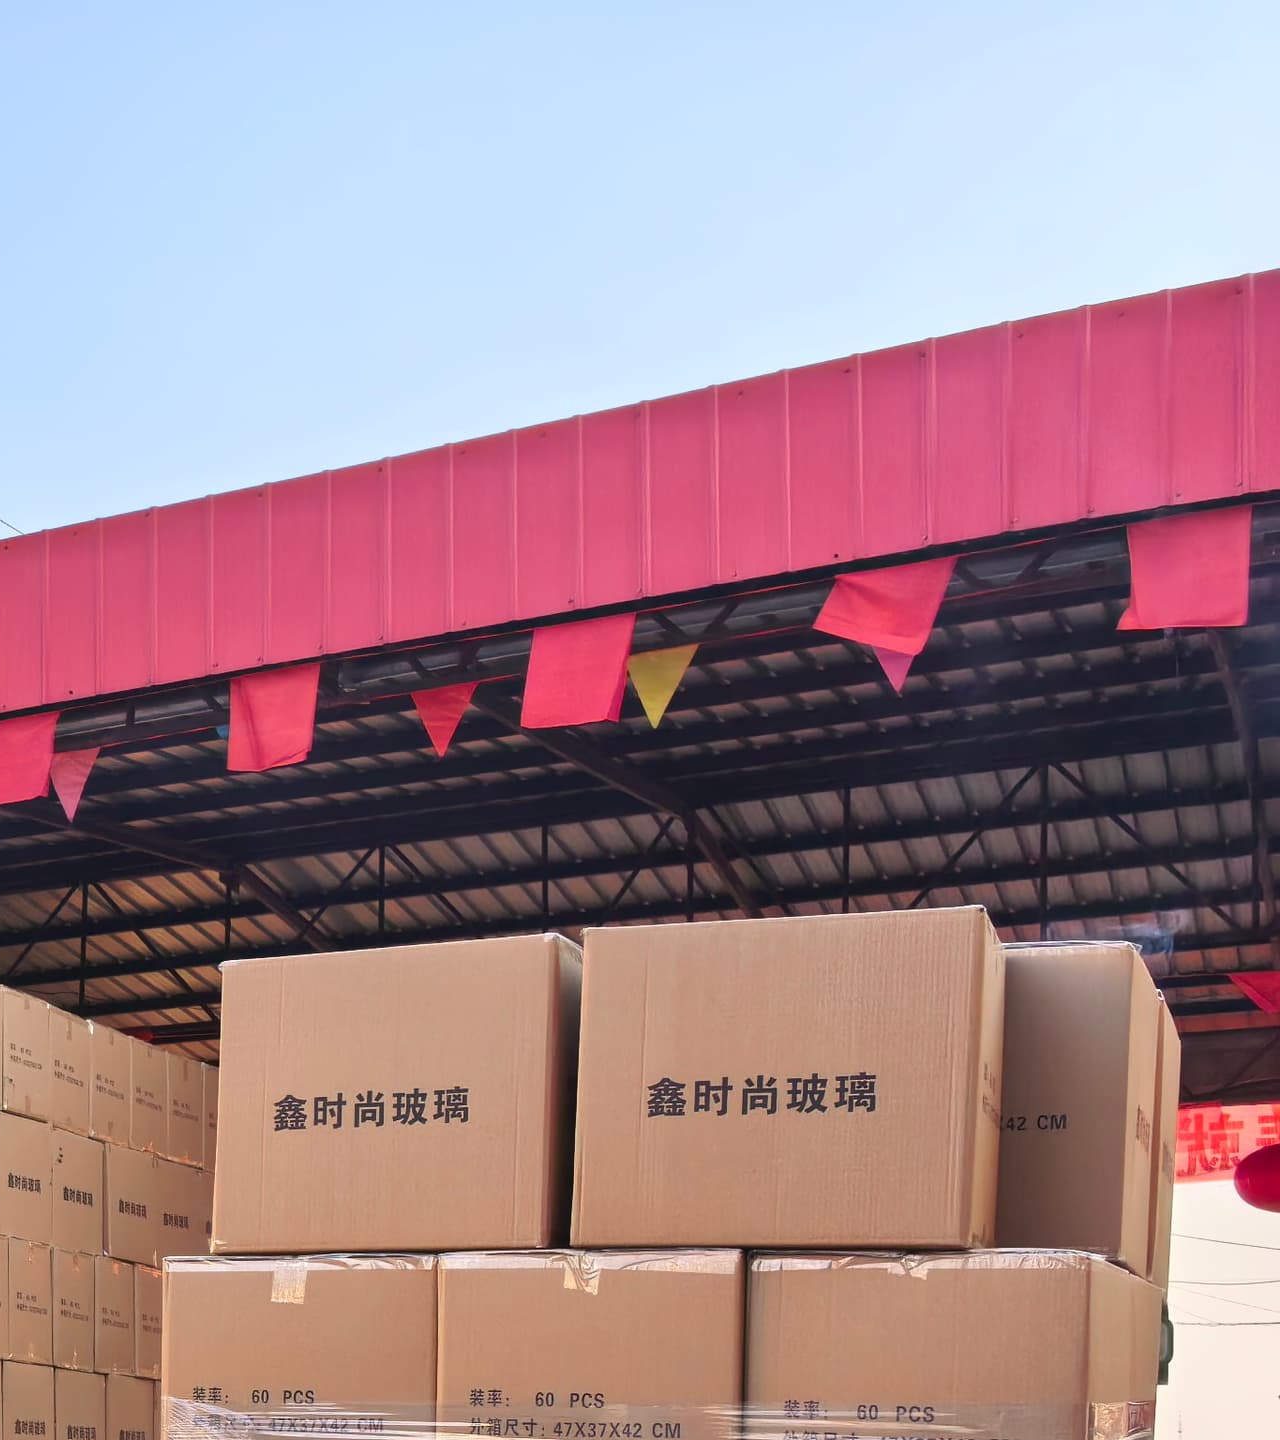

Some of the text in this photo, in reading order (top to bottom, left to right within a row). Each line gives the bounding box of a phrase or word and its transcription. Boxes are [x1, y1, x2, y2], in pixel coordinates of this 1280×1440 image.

[646, 1071, 878, 1118] 鑫时尚玻璃
[274, 1086, 469, 1132] 鑫时尚玻璃
[1000, 1114, 1068, 1131] 42 CM
[252, 1389, 270, 1404] 60
[283, 1390, 315, 1405] PCS
[535, 1392, 555, 1407] 60
[569, 1393, 605, 1408] PCS
[856, 1403, 879, 1421] 60
[895, 1405, 935, 1423] PCS
[269, 1417, 349, 1432] 47X37X42
[357, 1418, 384, 1433] CM
[553, 1421, 642, 1439] 47X37X42
[652, 1422, 682, 1440] CM
